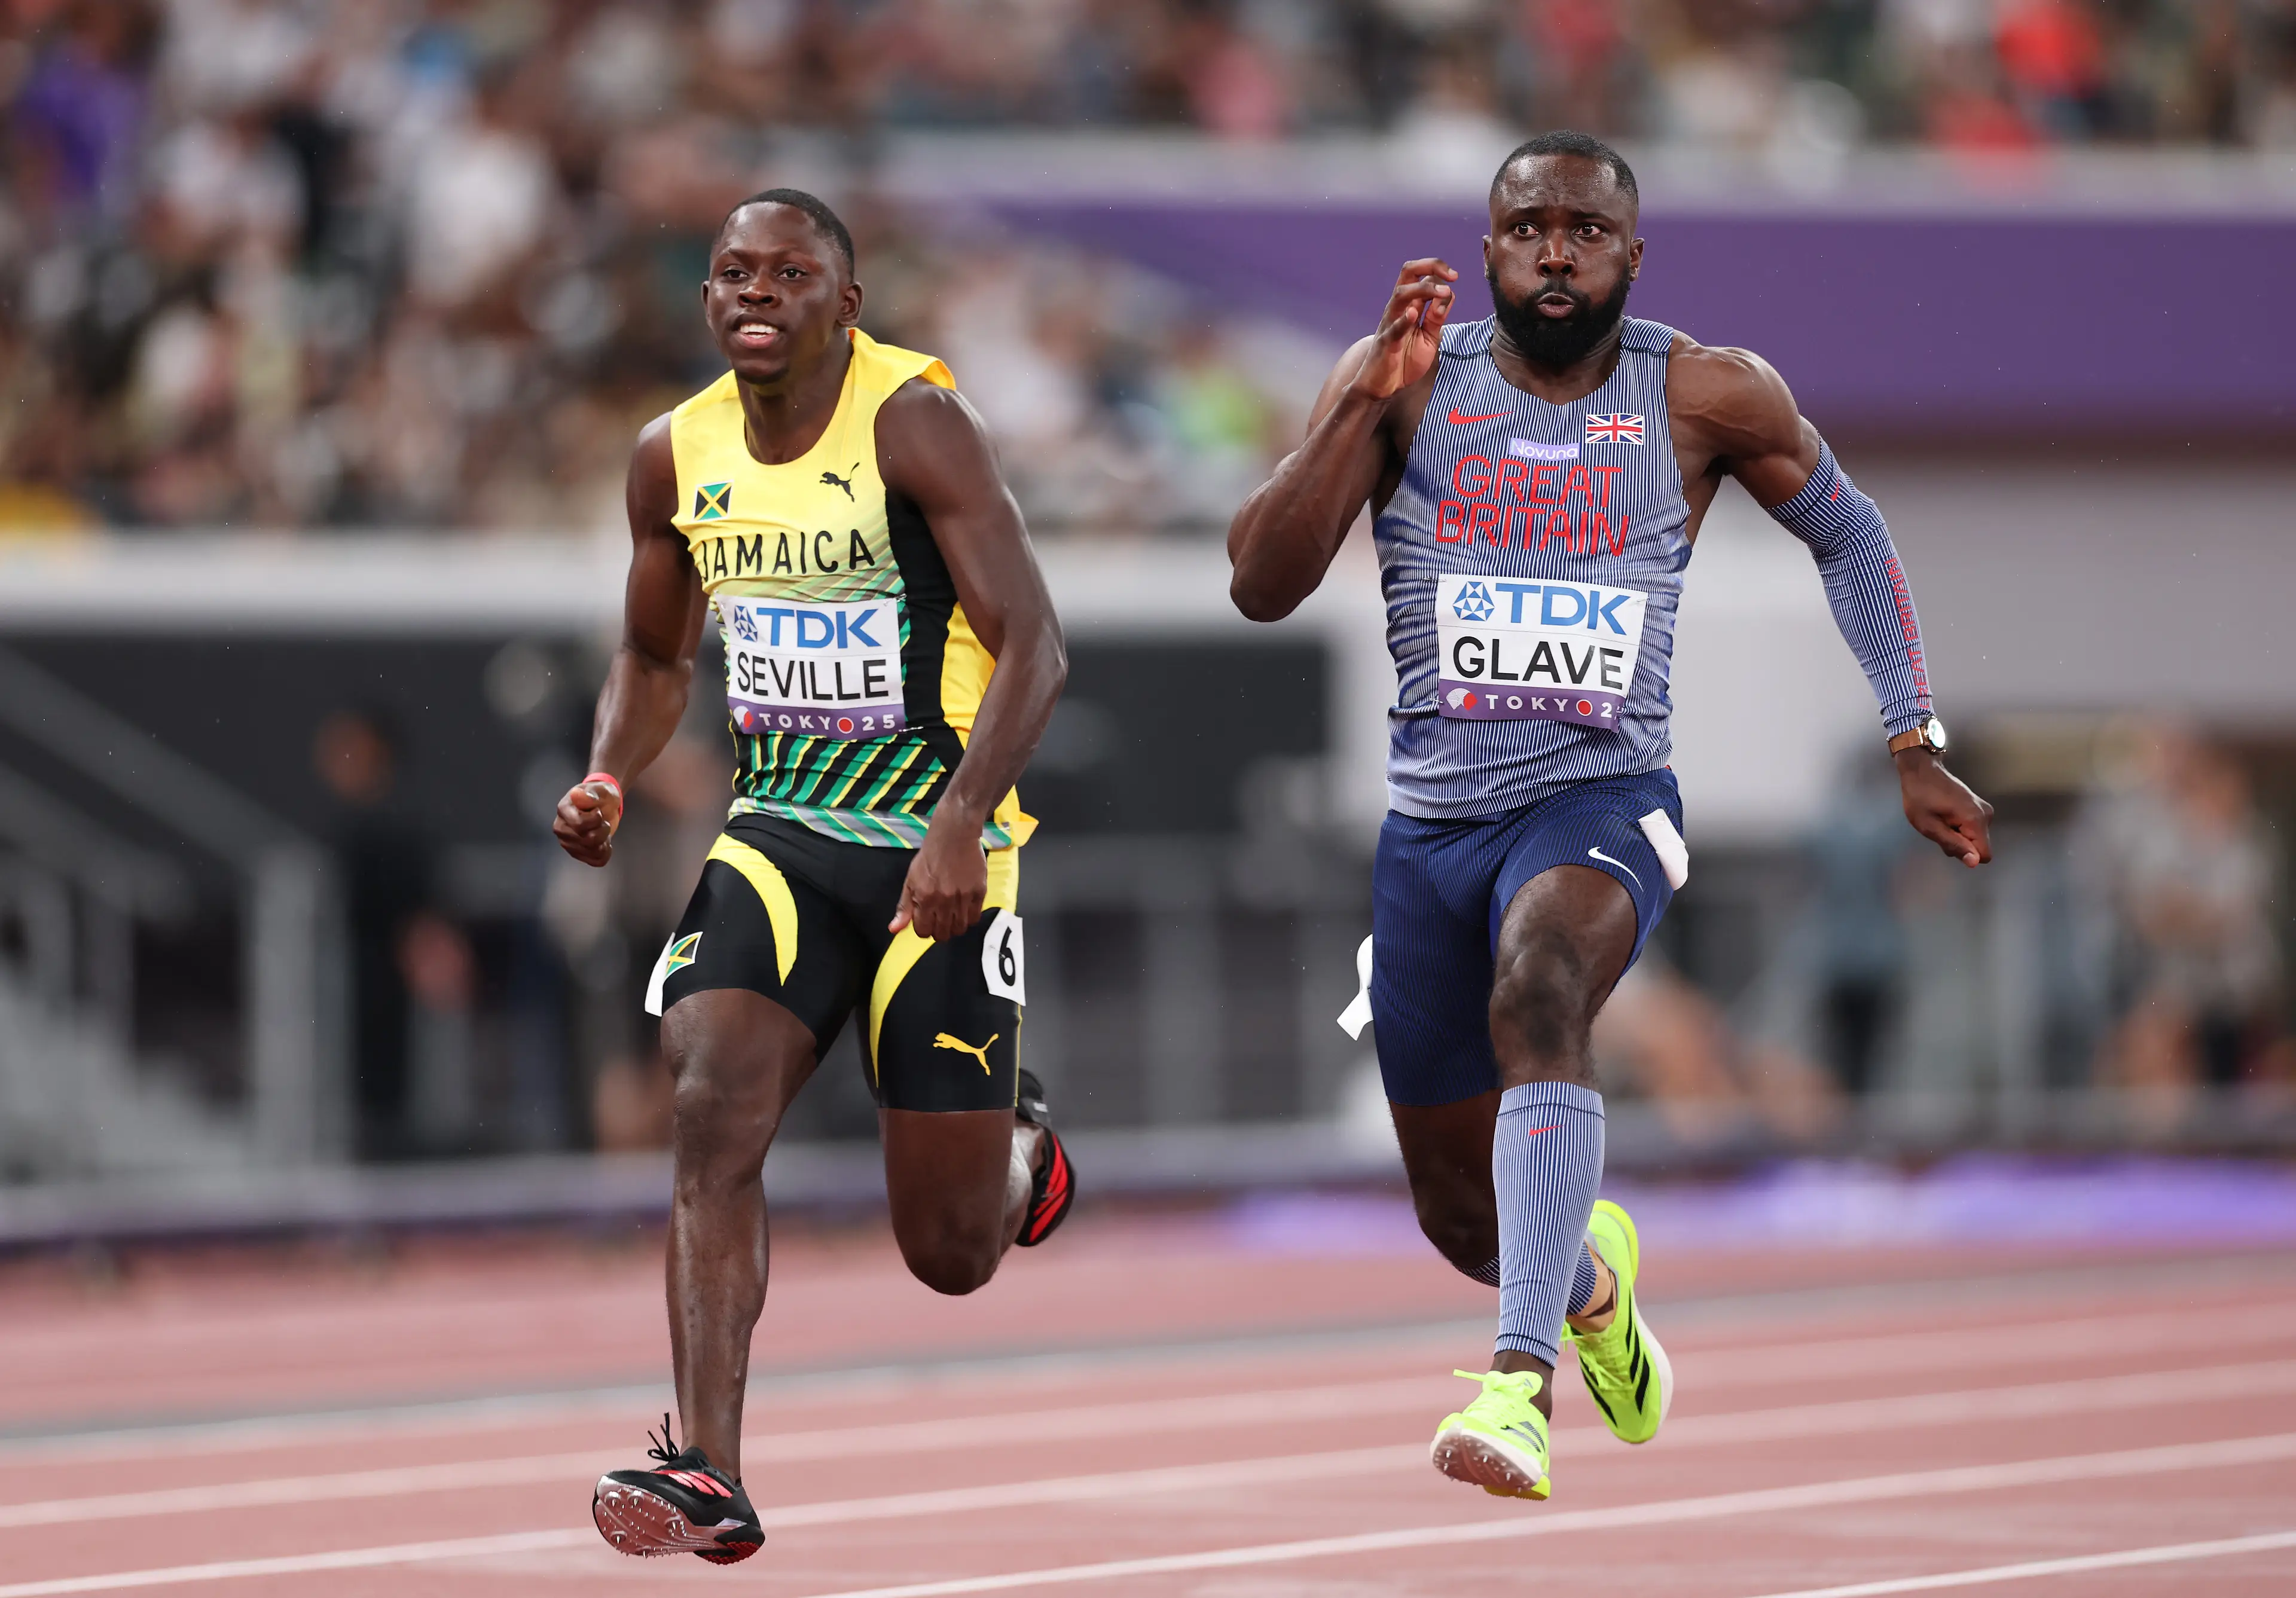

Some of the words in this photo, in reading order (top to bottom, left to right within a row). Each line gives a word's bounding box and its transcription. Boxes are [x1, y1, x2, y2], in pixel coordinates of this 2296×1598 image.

[1511, 439, 1578, 459] Novuna
[1453, 454, 1623, 508] GREAT
[1436, 500, 1629, 557] BRITAIN
[701, 529, 875, 582] JAMAICA
[1495, 583, 1631, 635] TDK
[1885, 557, 1918, 641] BRITAIN
[756, 607, 881, 649] TDK
[738, 652, 889, 701] SEVILLE
[1453, 636, 1624, 690] GLAVE
[999, 926, 1016, 986] 6
